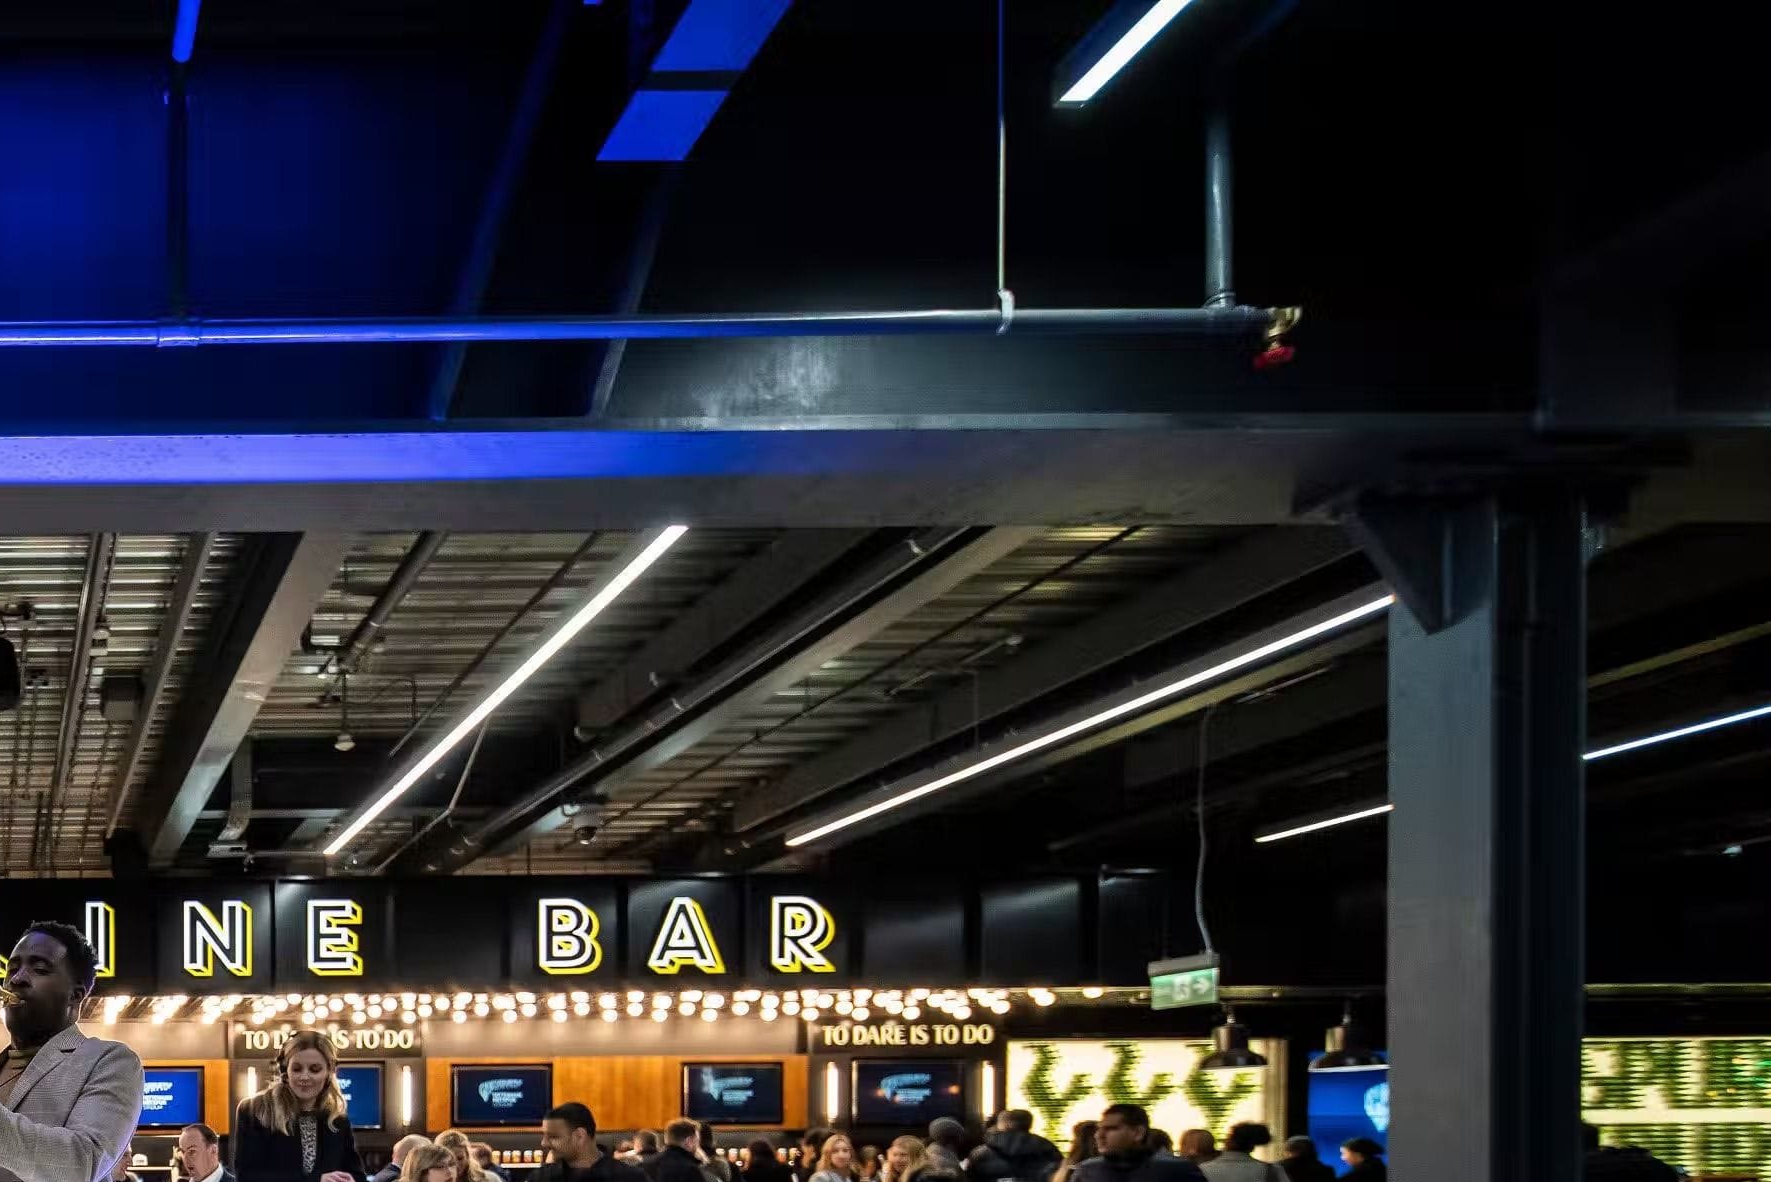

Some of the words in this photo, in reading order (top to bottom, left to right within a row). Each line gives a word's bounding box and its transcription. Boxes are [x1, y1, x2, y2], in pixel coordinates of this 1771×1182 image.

[538, 896, 836, 975] BAR
[242, 1030, 270, 1050] TO
[353, 1030, 380, 1050] TO
[383, 1029, 414, 1049] DO
[822, 1025, 849, 1045] TO
[852, 1024, 907, 1045] DARE
[910, 1024, 929, 1044] IS
[932, 1024, 959, 1044] TO
[962, 1024, 994, 1044] DO
